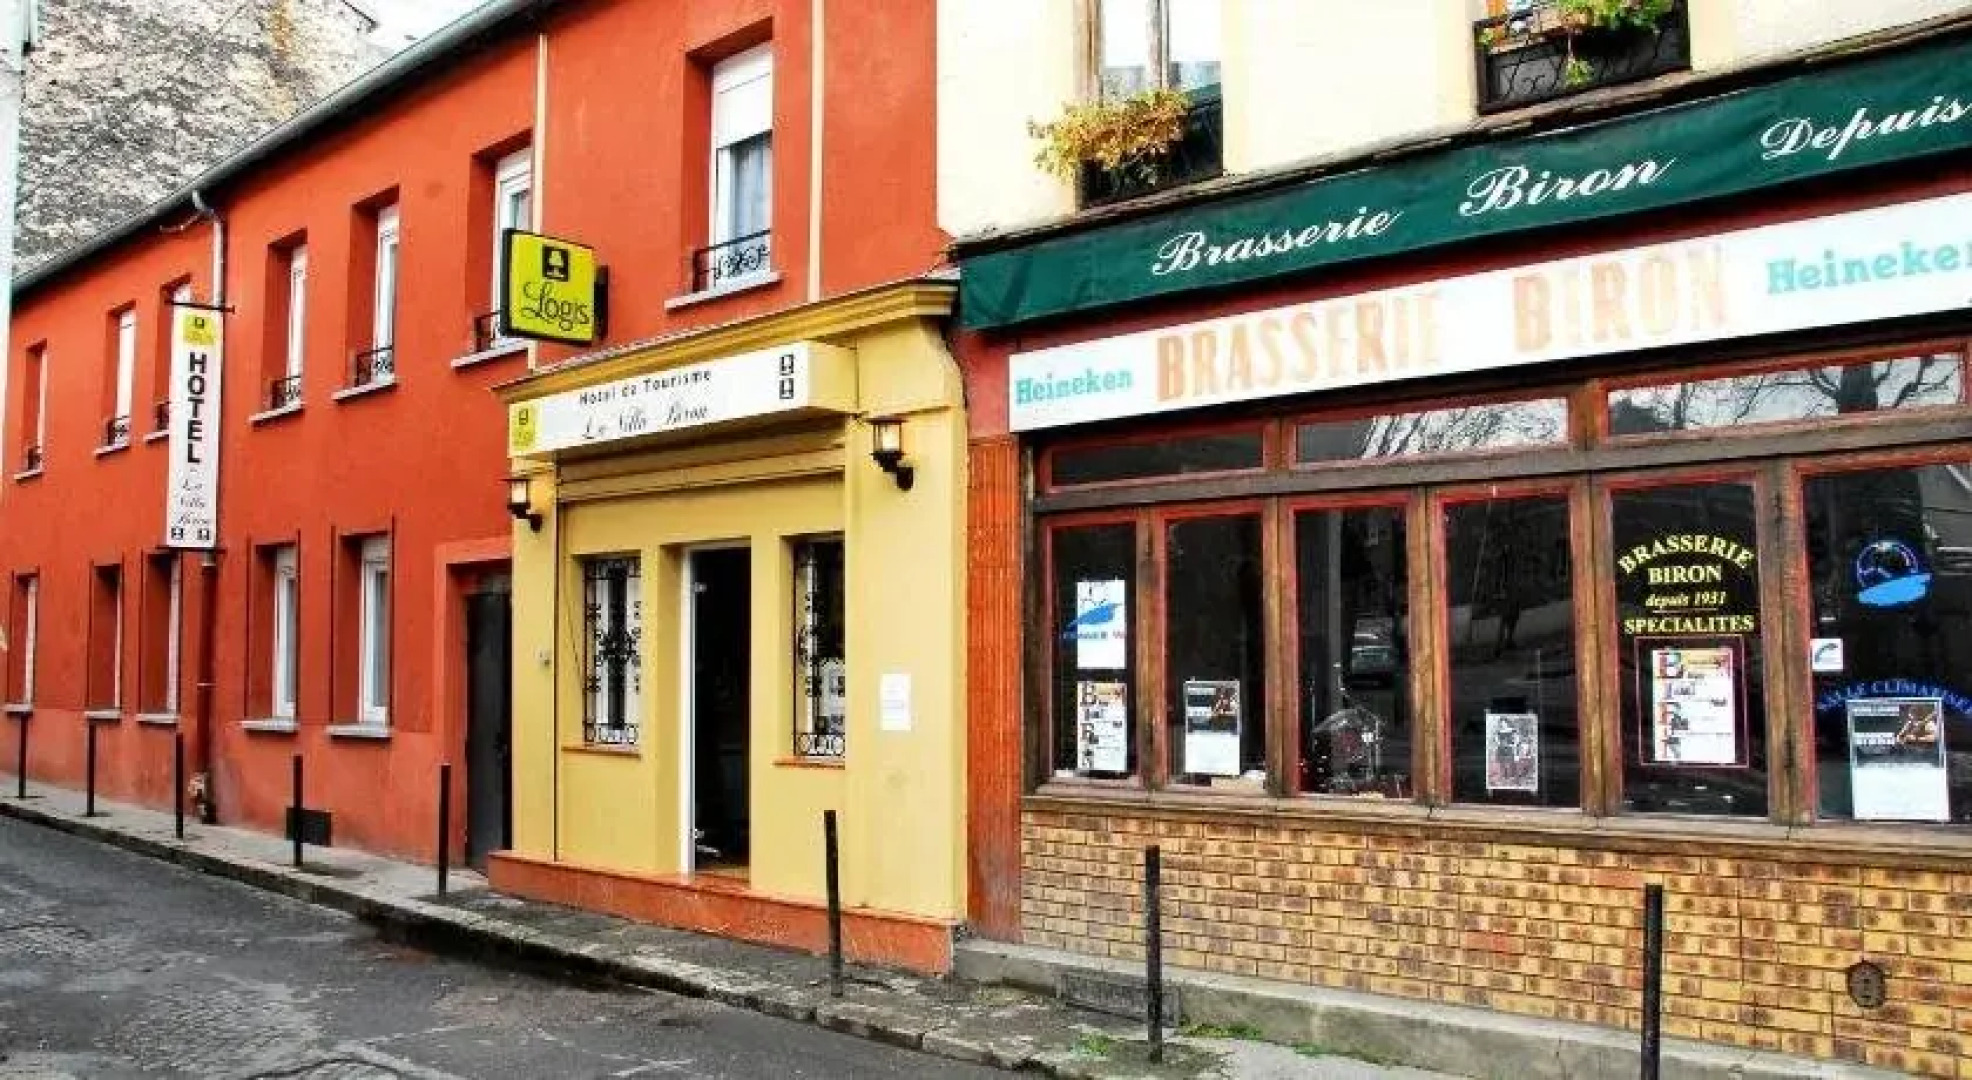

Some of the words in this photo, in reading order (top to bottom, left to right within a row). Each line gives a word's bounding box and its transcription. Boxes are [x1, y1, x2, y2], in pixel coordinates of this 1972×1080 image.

[1152, 207, 1404, 276] Brasserie
[1458, 156, 1677, 217] Biron
[1760, 96, 1972, 160] Depuis
[521, 281, 590, 332] Logis
[1015, 368, 1135, 406] Heineken
[1157, 292, 1443, 403] BRASSERIE
[1512, 243, 1727, 352] BIRON
[643, 370, 712, 392] Tourisme
[187, 352, 207, 463] HOTEL
[1617, 535, 1755, 574] BRASSERIE
[1647, 565, 1722, 585] BIRON
[1645, 592, 1690, 610] depuis
[1624, 614, 1755, 635] SPECIALITES
